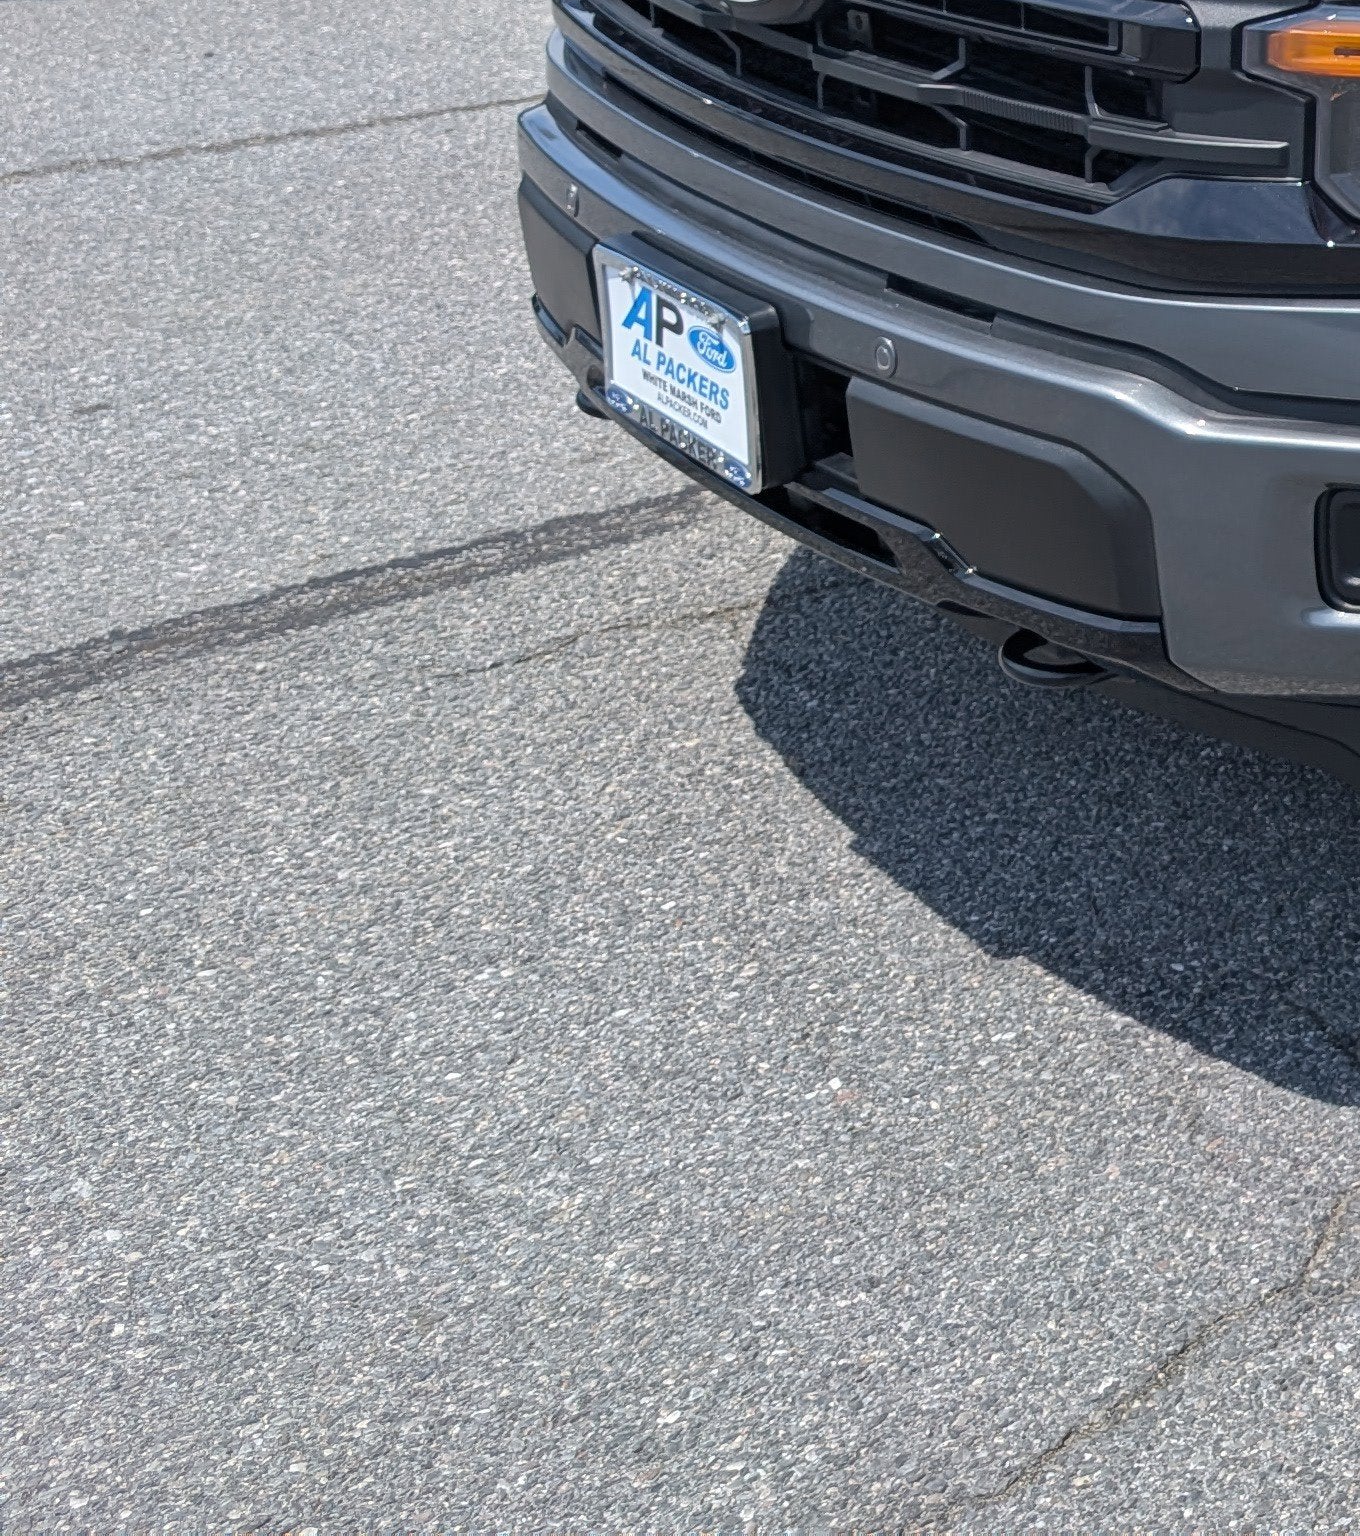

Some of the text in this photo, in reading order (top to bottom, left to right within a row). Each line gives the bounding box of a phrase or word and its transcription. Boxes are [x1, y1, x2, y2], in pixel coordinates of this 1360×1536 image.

[622, 286, 684, 348] AP
[631, 338, 730, 411] AL PACKERS
[697, 331, 728, 369] Ford
[641, 368, 722, 424] WHITE MARSH FORD
[656, 391, 709, 430] ALPACKER.COM
